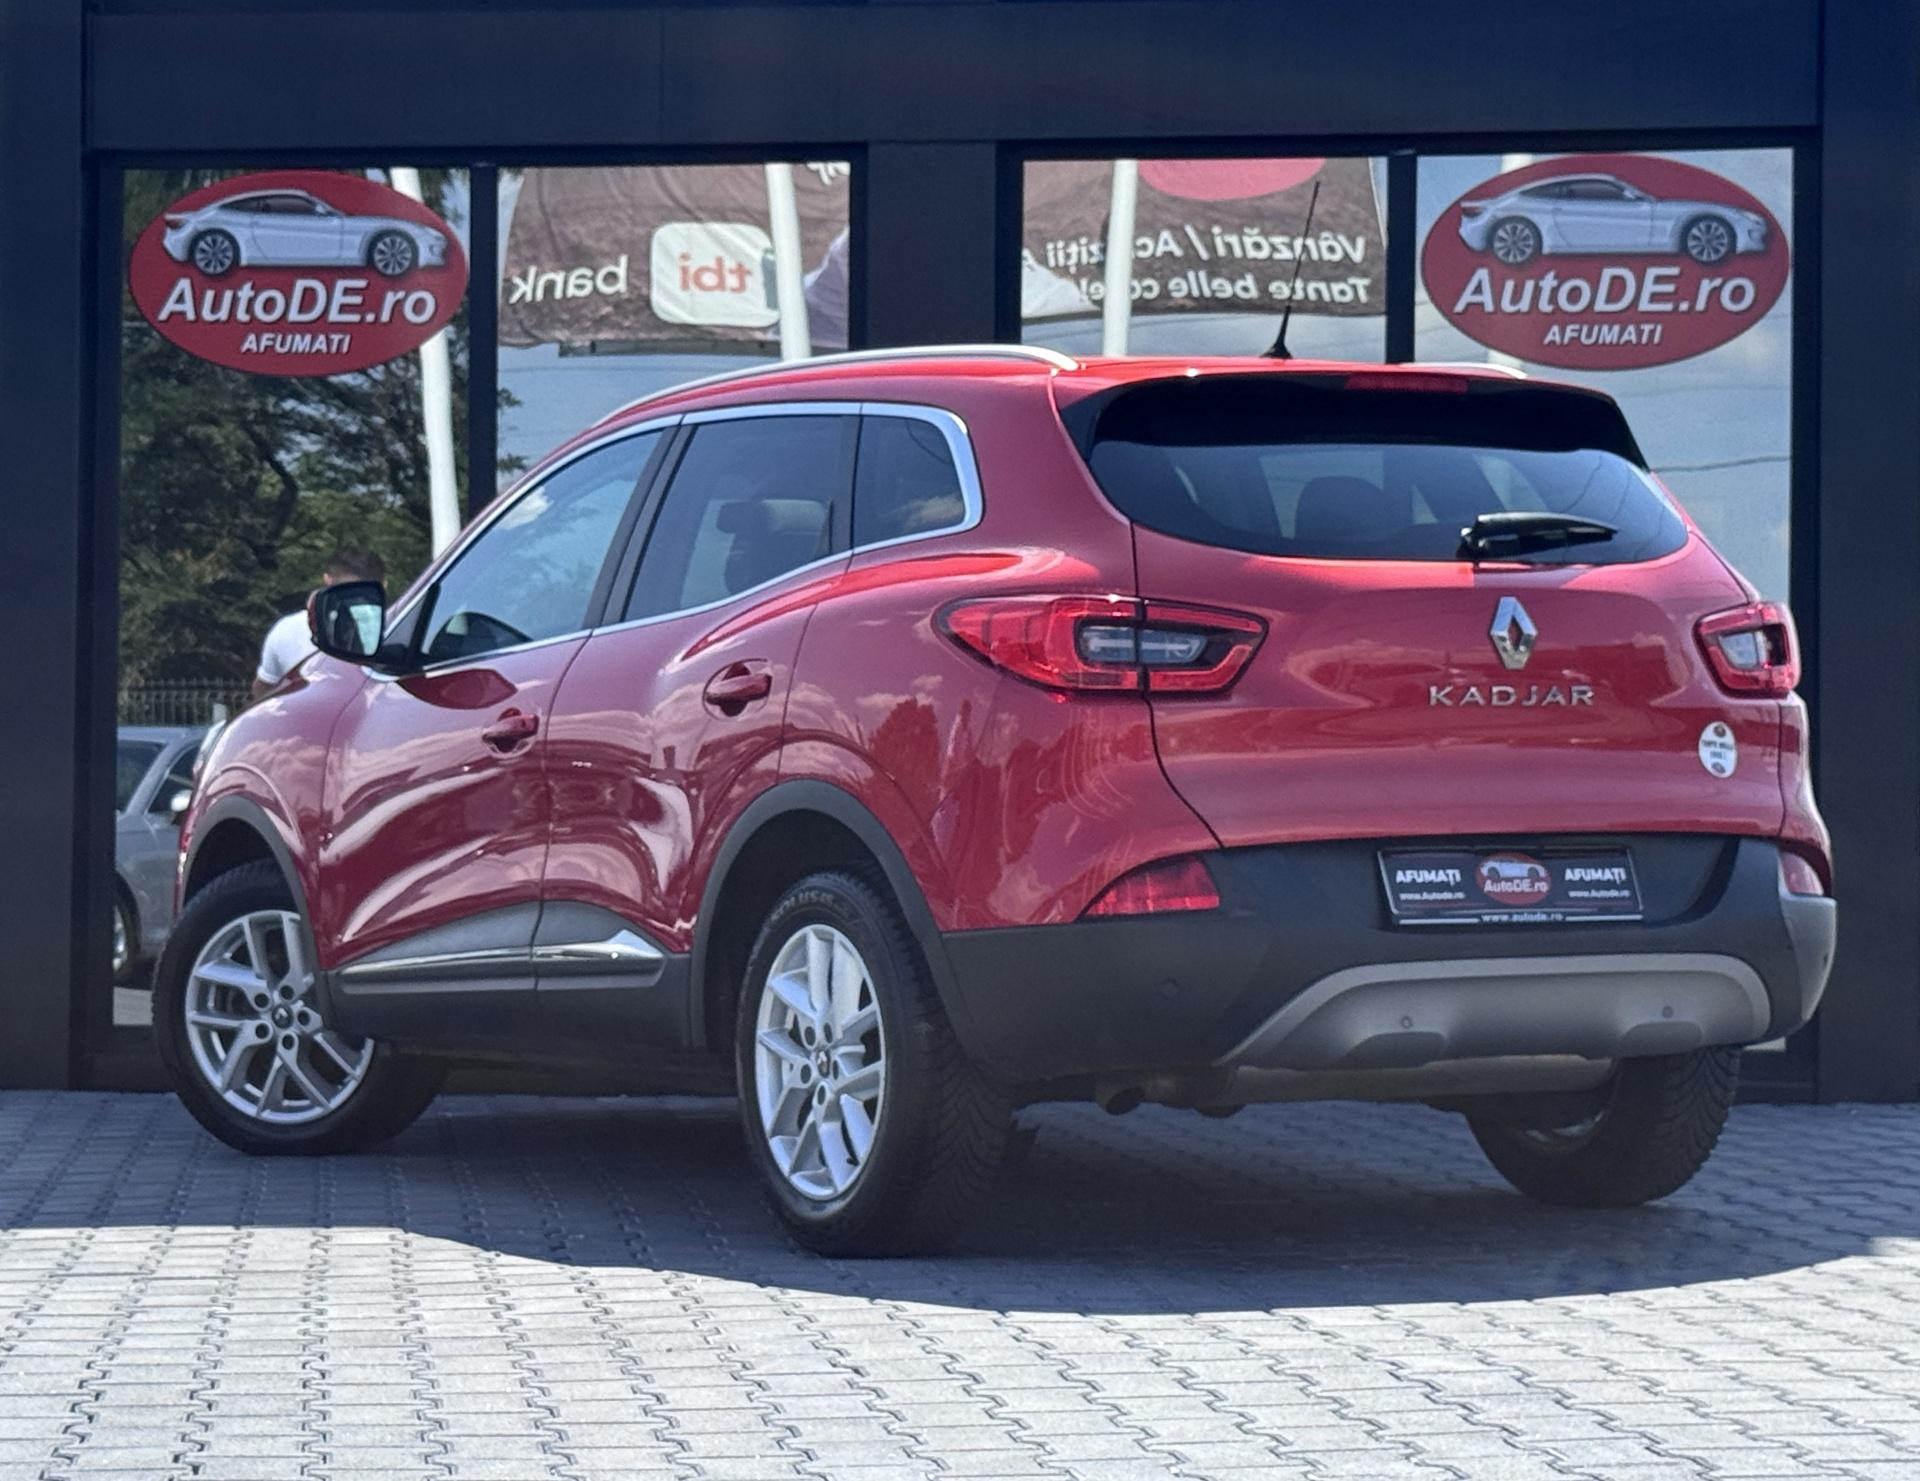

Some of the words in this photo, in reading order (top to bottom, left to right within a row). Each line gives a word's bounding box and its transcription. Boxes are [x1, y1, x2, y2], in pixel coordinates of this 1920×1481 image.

[158, 277, 437, 324] AutoDE.ro
[1453, 265, 1756, 314] AutoDE.ro
[241, 332, 351, 355] AFUMATI
[1543, 323, 1664, 346] AFUMATI
[1428, 685, 1596, 706] KADJAR
[1484, 878, 1549, 893] AutoDE.ro
